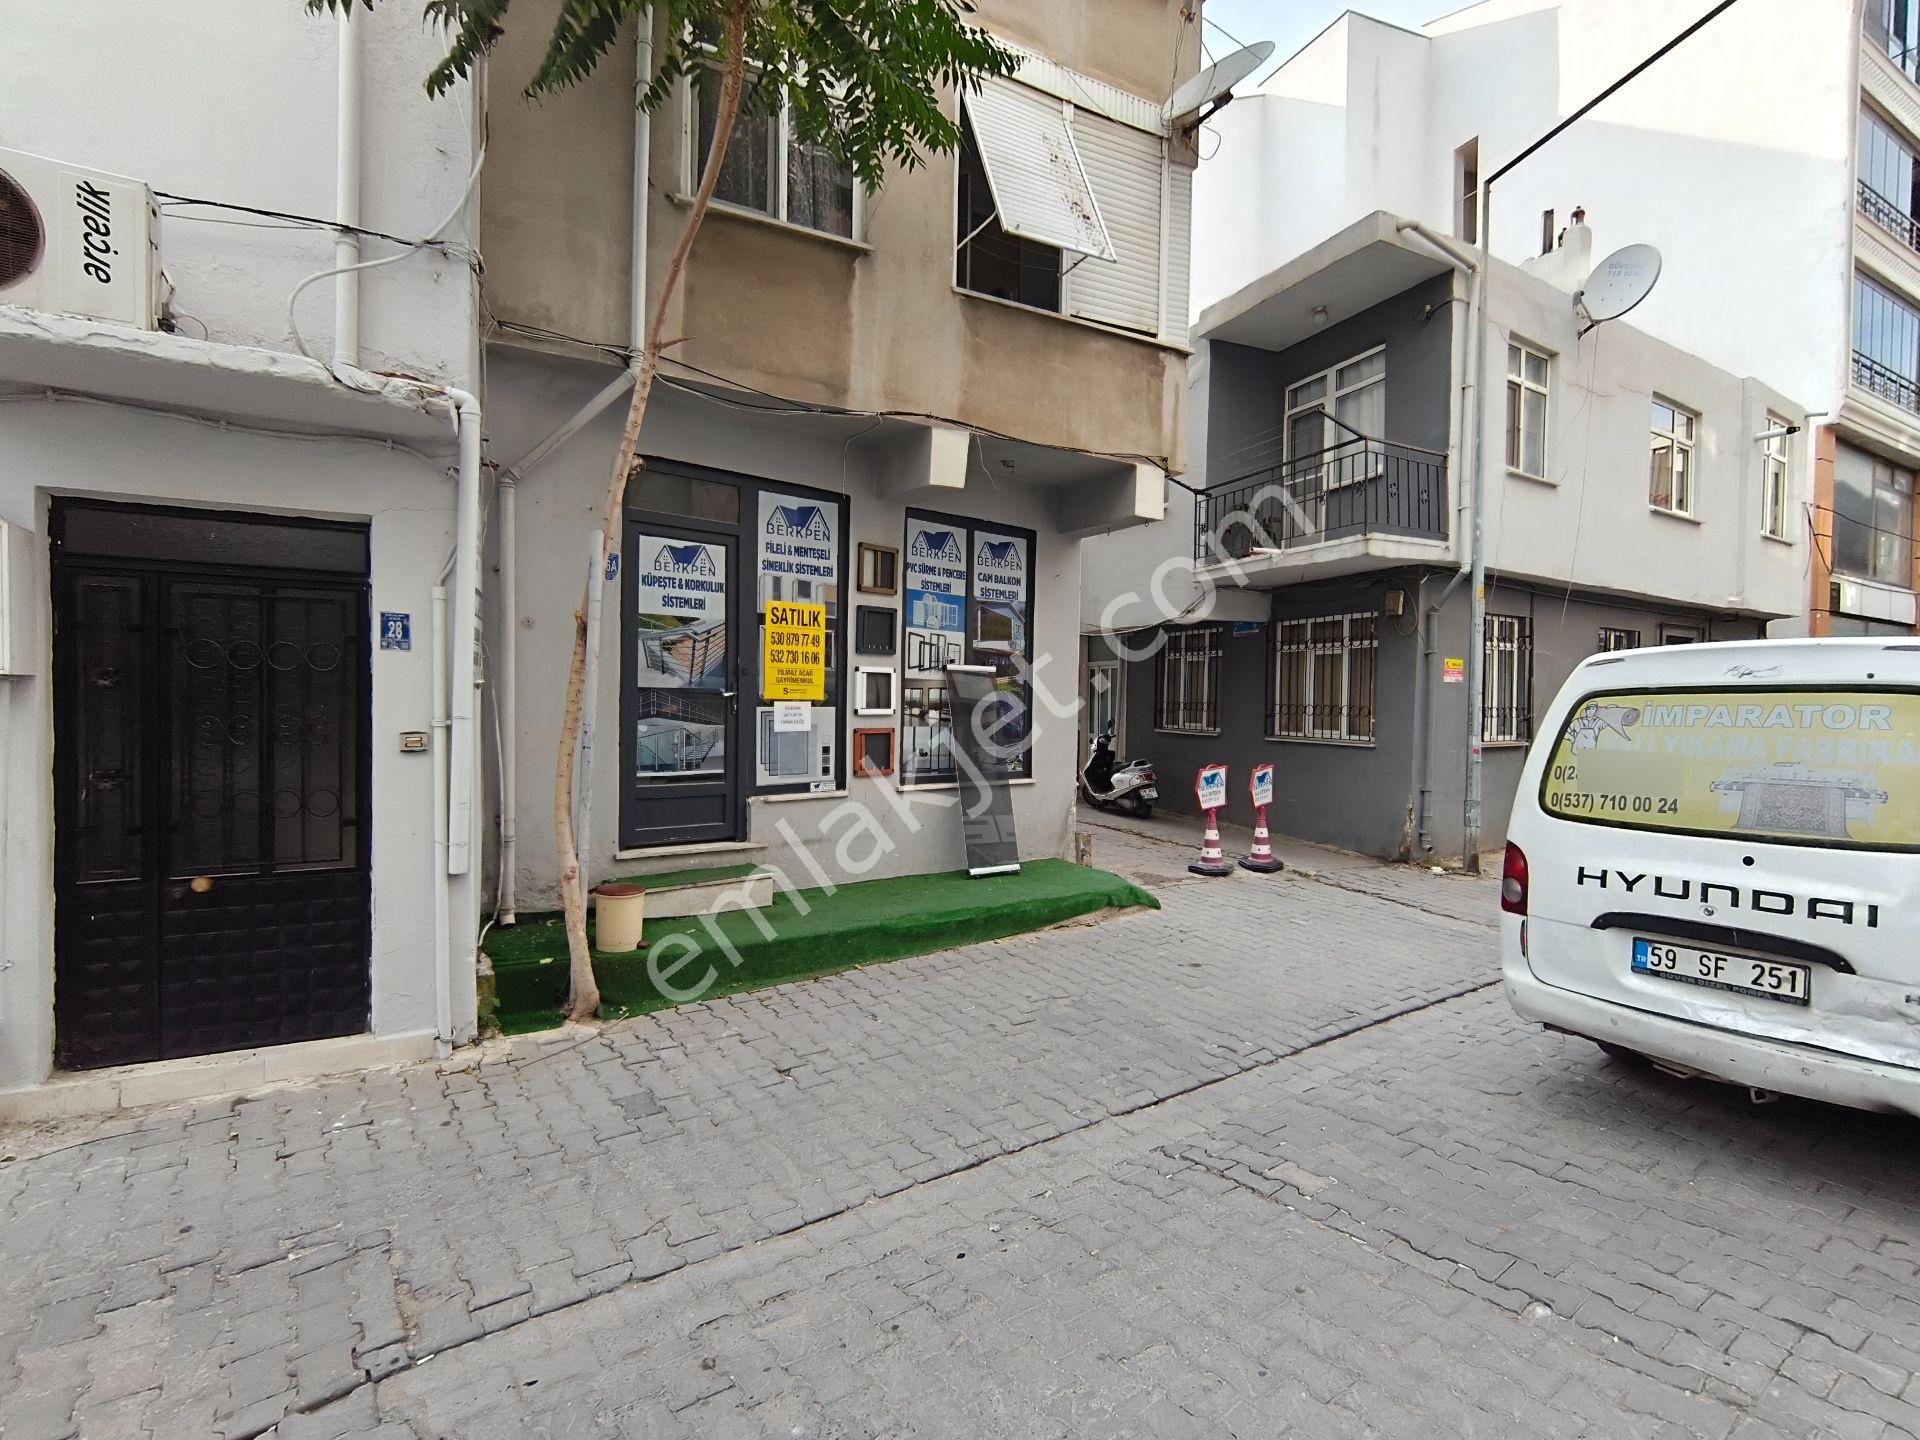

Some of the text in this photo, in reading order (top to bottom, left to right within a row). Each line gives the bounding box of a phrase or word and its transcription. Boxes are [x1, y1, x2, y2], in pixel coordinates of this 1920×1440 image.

[76, 180, 119, 284] arçelik
[766, 521, 831, 543] BERKPEN
[765, 540, 831, 561] FİLELİ & MENTEŞELİ
[912, 545, 962, 563] BERKPEN
[654, 559, 716, 577] BERKPEN
[762, 558, 834, 578] SİNEKLİK SİSTEMLERİ
[907, 562, 967, 581] PVC SÜRME & PENCERE
[977, 555, 1022, 571] BERKPEN
[641, 572, 725, 594] KÜPEŞTE & KORKULUK
[920, 579, 952, 594] SİSTEMLERİ
[977, 572, 1021, 587] CAM BALKON
[662, 593, 706, 611] SİSTEMLERİ
[980, 586, 1019, 601] SİSTEMLERİ
[770, 606, 821, 628] SATILIK
[388, 620, 403, 640] 28
[770, 632, 820, 648] 530 879 77 49
[770, 649, 820, 665] 532 730 16 06
[1641, 701, 1893, 730] İMPARATOR
[1551, 792, 1678, 814] 0(537) 710 00 24
[1577, 866, 1879, 928] HYUNDAI
[1636, 955, 1647, 964] TR
[1650, 946, 1798, 993] 59 SF 251
